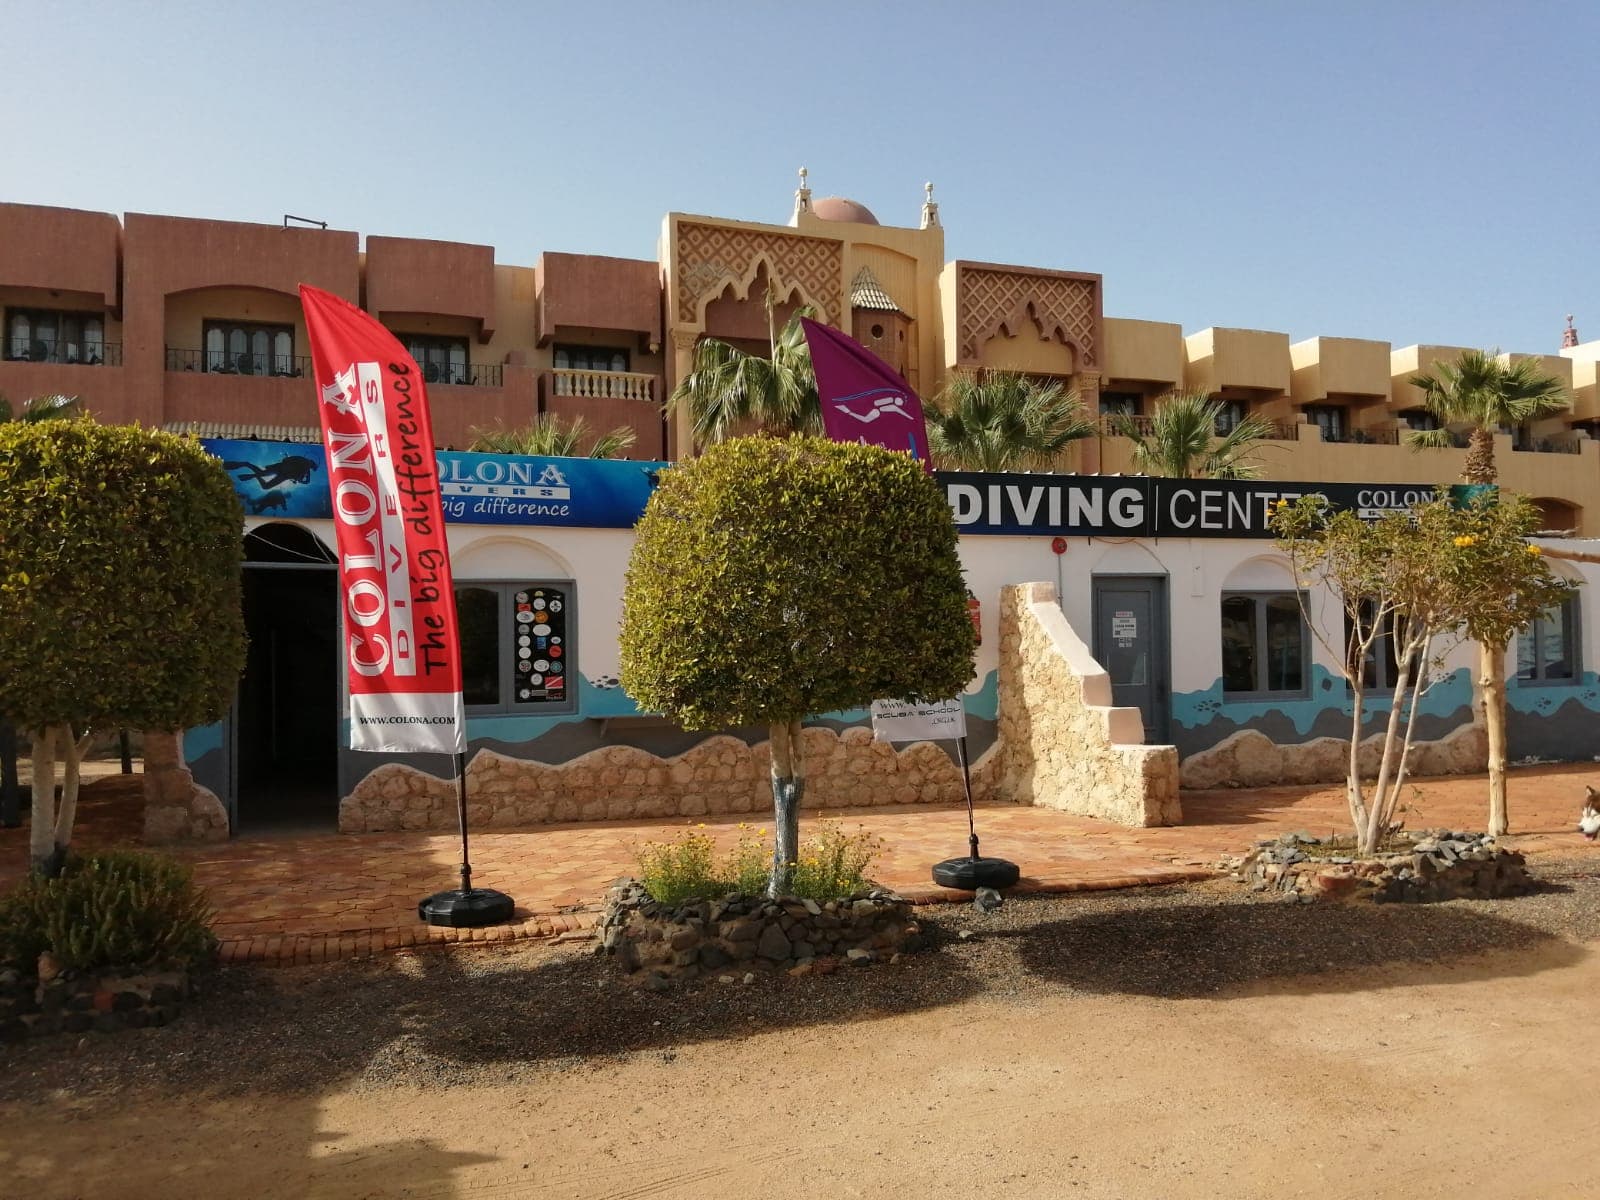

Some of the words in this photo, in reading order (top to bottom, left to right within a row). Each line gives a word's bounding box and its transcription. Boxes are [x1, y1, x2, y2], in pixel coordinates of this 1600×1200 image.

[388, 361, 435, 536] difference
[436, 459, 570, 487] LONA
[441, 484, 554, 497] VERS
[473, 497, 570, 517] difference
[947, 483, 1145, 528] DIVING
[322, 362, 391, 677] COLONA
[366, 379, 410, 659] DIVERS
[410, 548, 445, 603] big
[419, 614, 448, 676] The
[359, 716, 456, 725] WWW.COLONA.COM
